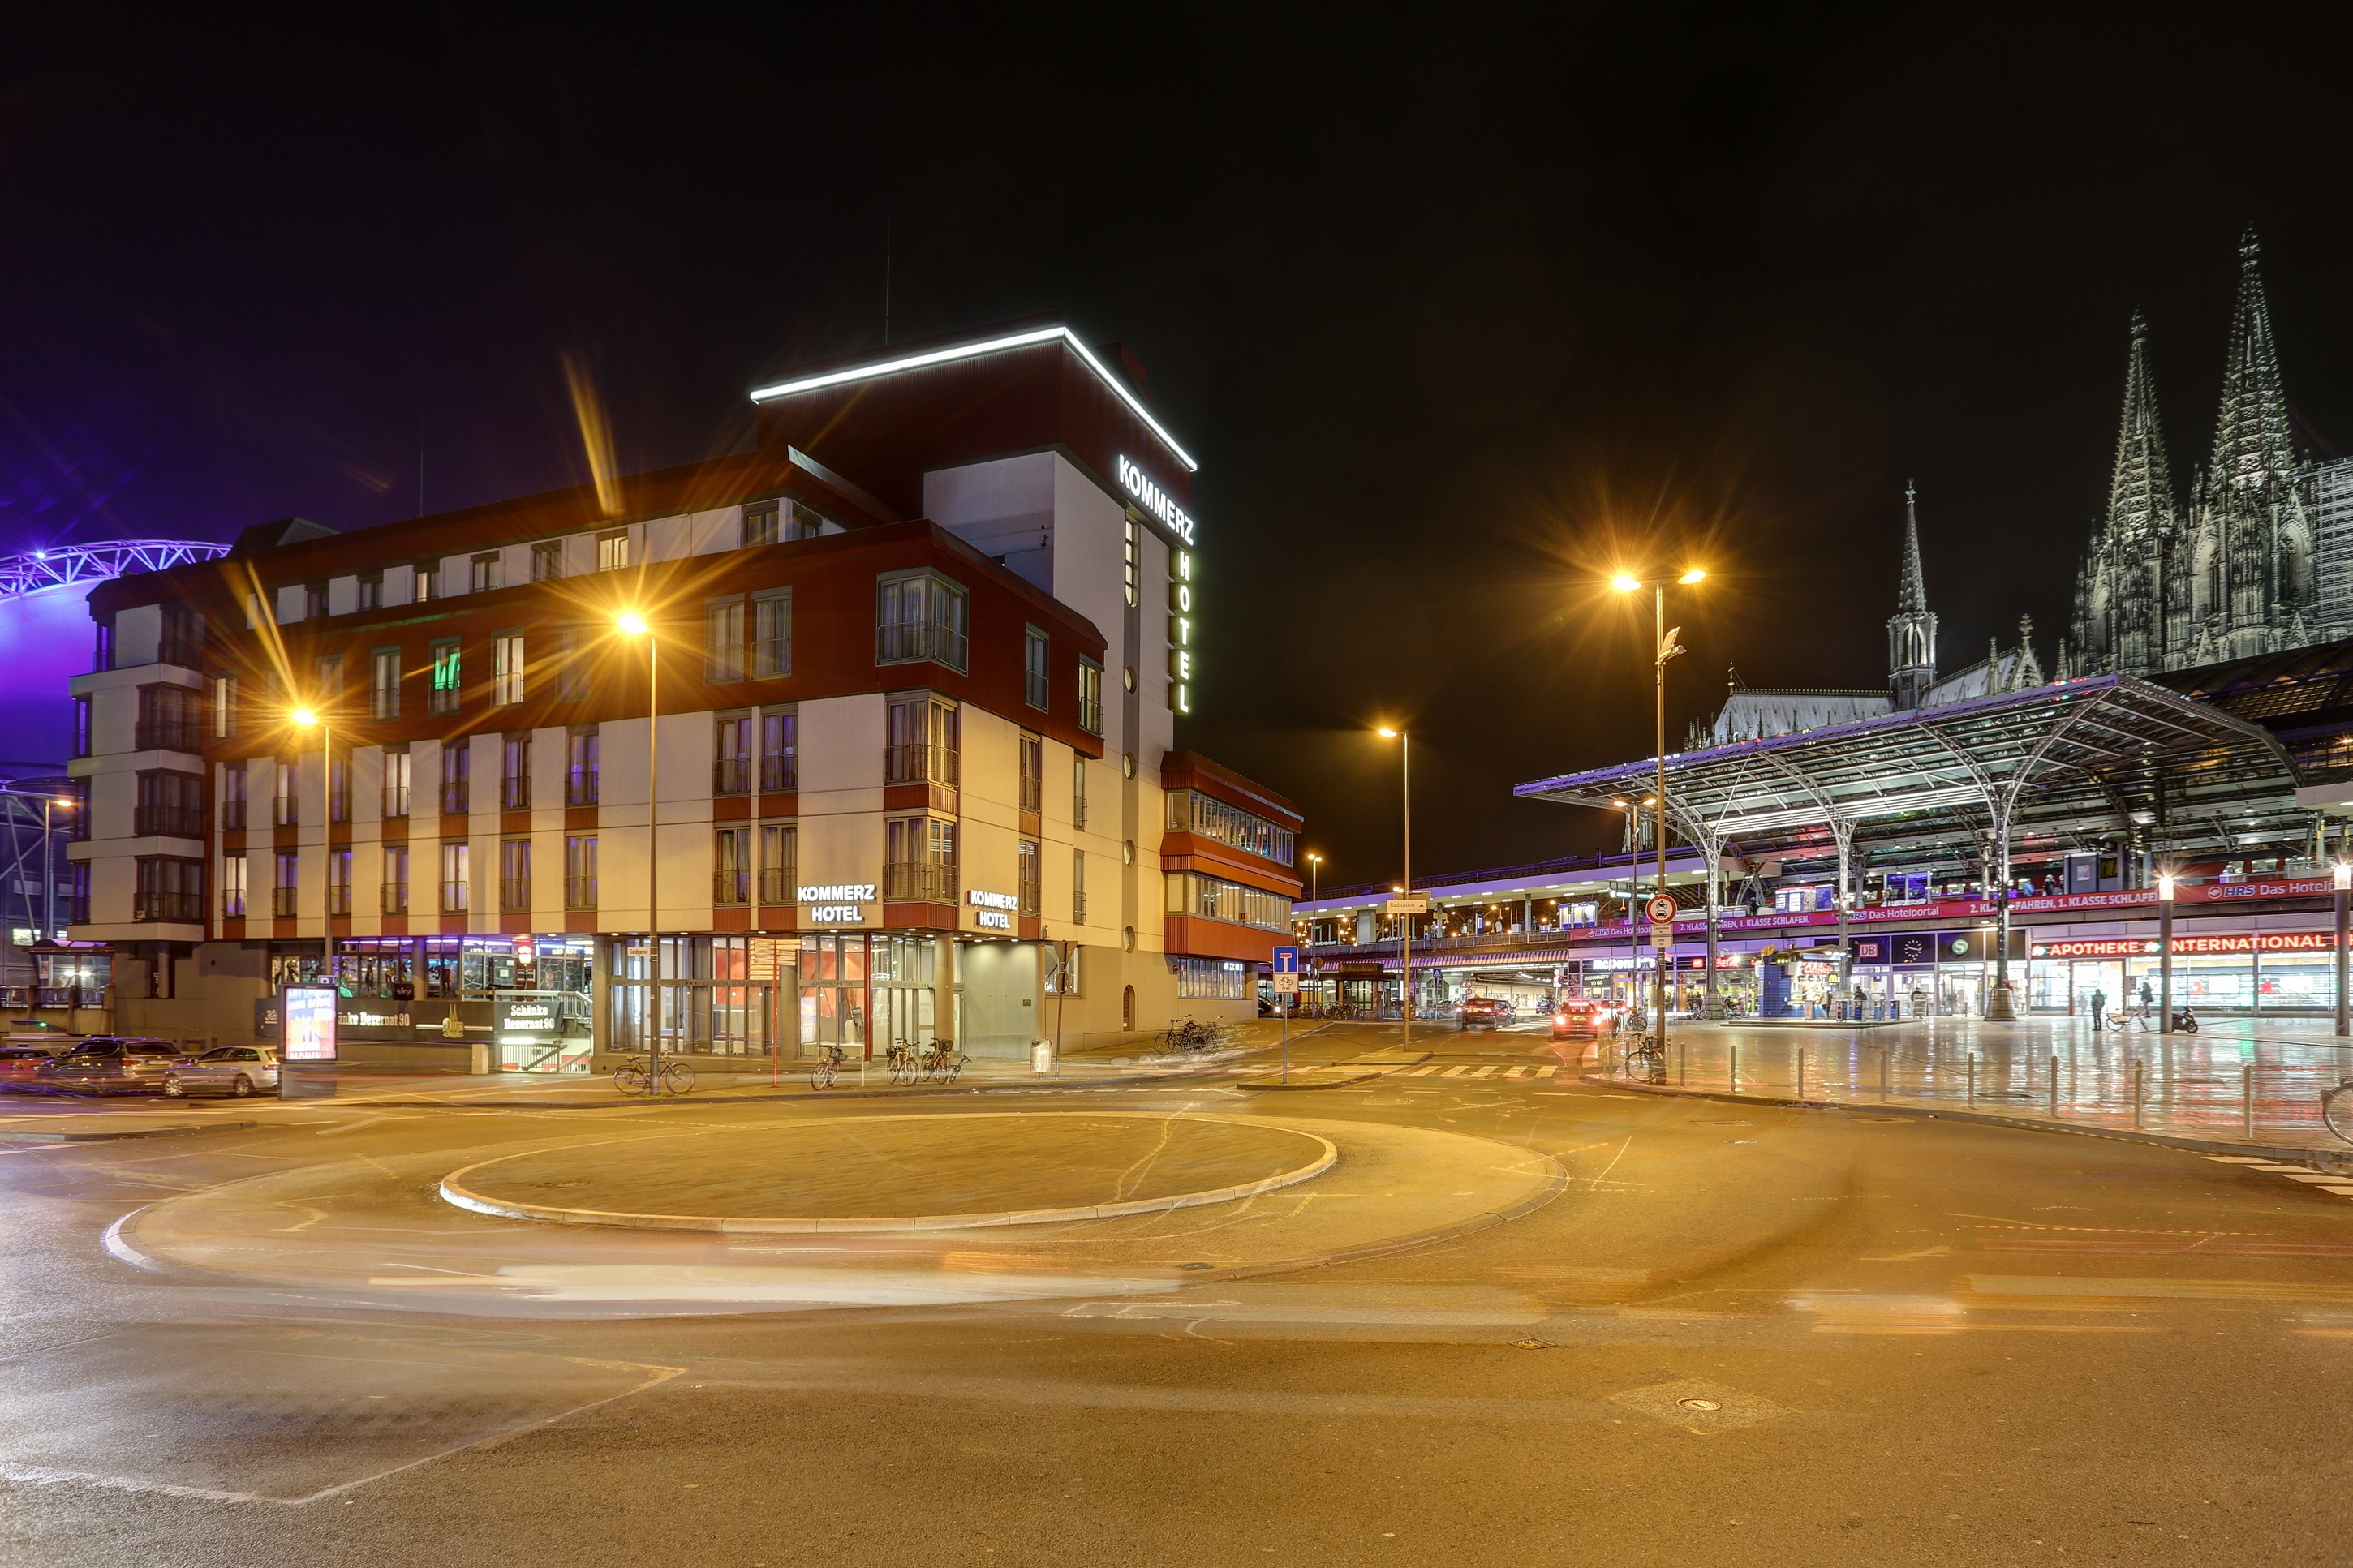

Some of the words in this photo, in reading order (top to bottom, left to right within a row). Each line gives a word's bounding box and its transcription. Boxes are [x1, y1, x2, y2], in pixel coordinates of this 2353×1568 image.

[1119, 453, 1194, 547] KOMMERZ
[1179, 550, 1190, 713] HOTEL
[798, 884, 875, 902] KOMMERZ
[2223, 885, 2256, 897] HRS
[2260, 884, 2285, 896] Das
[970, 889, 1018, 910] KOMMERZ
[1970, 904, 1979, 913] 2.
[2015, 898, 2056, 910] FAHREN,
[2058, 899, 2067, 908] 1.
[2069, 895, 2107, 907] KLASSE
[812, 905, 862, 921] HOTEL
[979, 911, 1011, 928] HOTEL
[1869, 909, 1886, 919] Das
[1887, 907, 1939, 919] Hotelportal
[1687, 922, 1707, 930] KLASS
[1747, 918, 1771, 927] KLASSE
[1772, 916, 1810, 926] SCHLAFEN.
[1595, 928, 1610, 936] HRS
[2050, 941, 2140, 956] APOTHEKE
[2171, 934, 2327, 952] NTERNATIONAL
[396, 987, 411, 996] sky
[510, 1004, 548, 1016] Schänke
[359, 1012, 398, 1026] Dezernat
[399, 1013, 410, 1027] 90
[504, 1018, 544, 1030] Dezernat
[544, 1017, 555, 1029] 90
